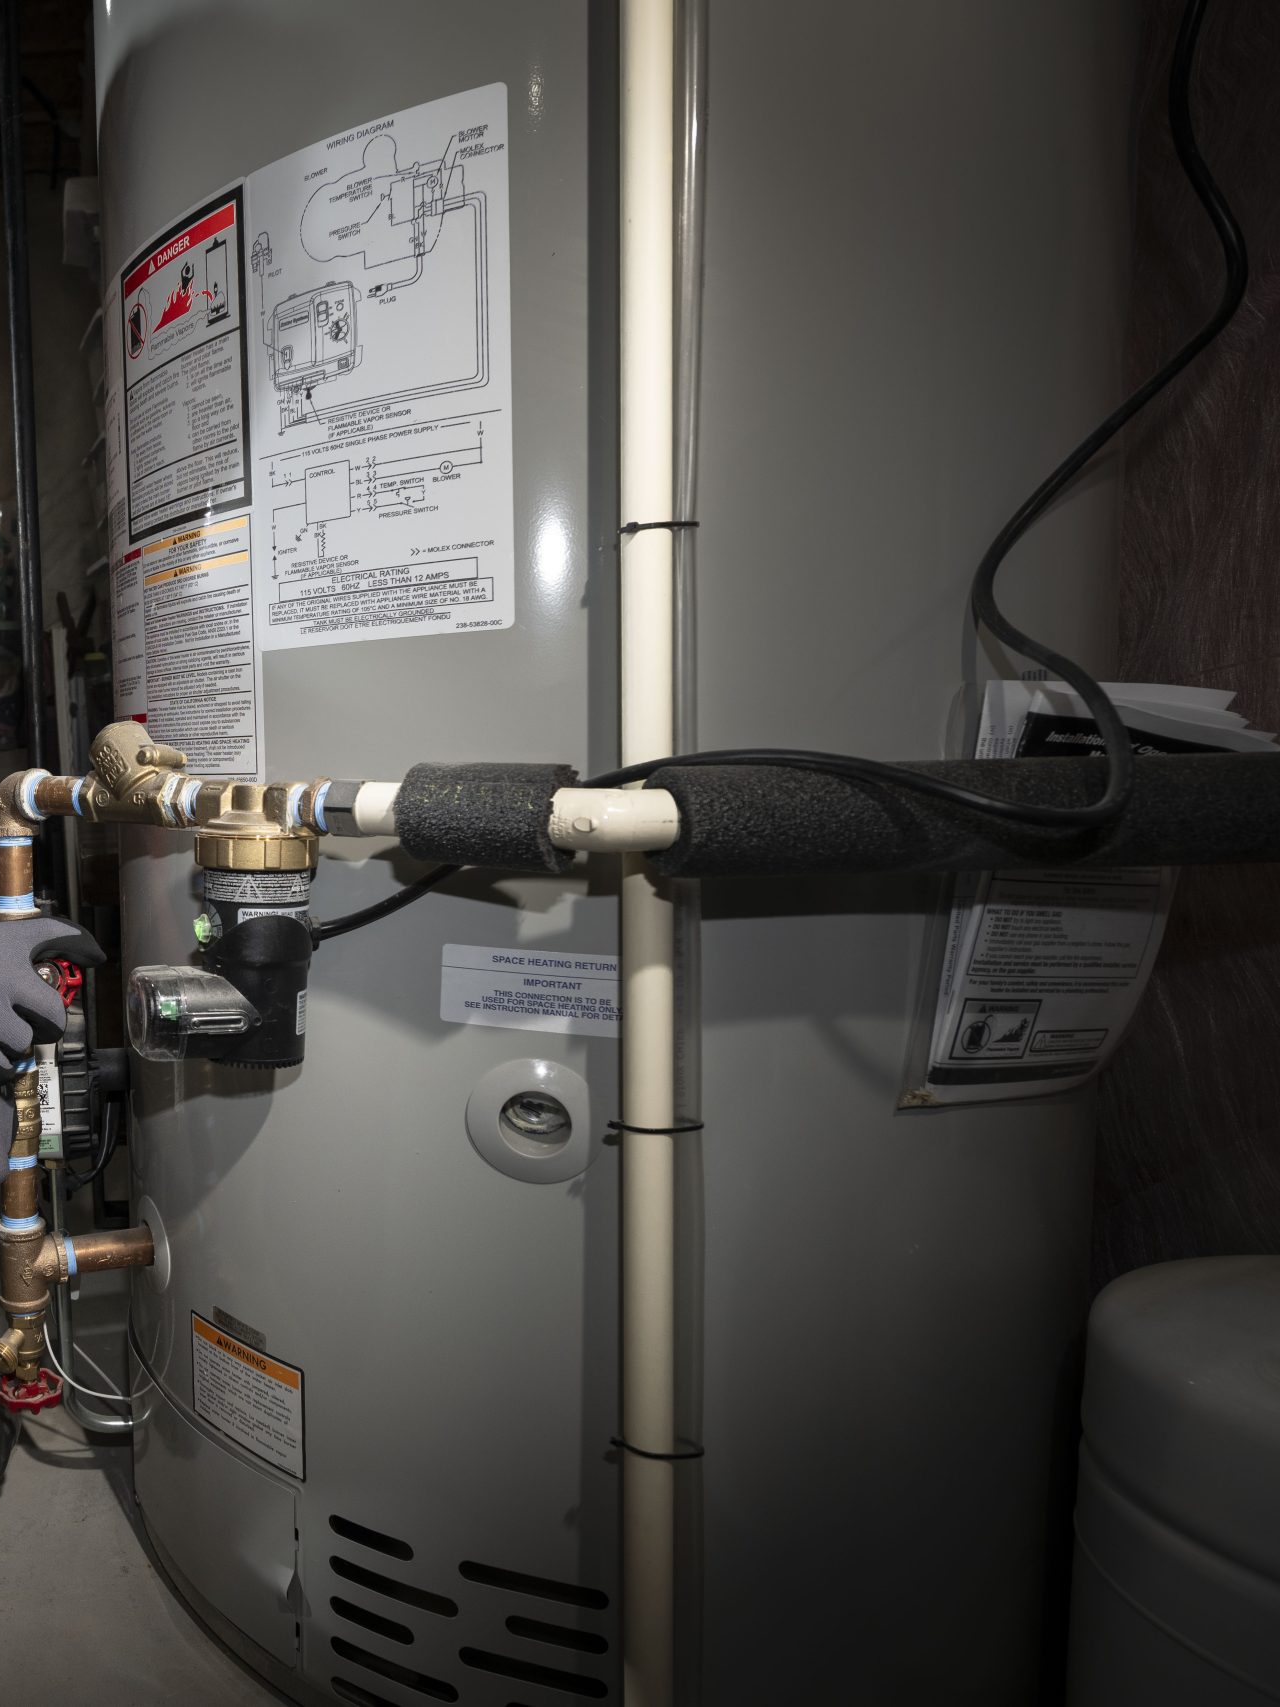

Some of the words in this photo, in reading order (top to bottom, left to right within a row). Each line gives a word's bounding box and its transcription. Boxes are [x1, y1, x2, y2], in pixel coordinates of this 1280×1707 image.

[326, 133, 355, 151] WIRING
[357, 119, 394, 142] DIAGRAM
[458, 124, 488, 137] BLOWER
[458, 132, 484, 144] MOTOR
[459, 143, 484, 154] MOLEX
[460, 143, 505, 160] CONNECTOR
[304, 167, 328, 182] BLOWER
[346, 177, 373, 191] BLOWER
[329, 183, 373, 203] TEMPERATURE
[349, 190, 373, 203] SWITCH
[328, 222, 361, 238] PRESSURE
[337, 229, 361, 241] SWITCH
[157, 235, 190, 267] DANGER
[379, 296, 396, 305] PLUG
[328, 411, 357, 424] RESISTIVE
[358, 408, 380, 417] DEVICE
[328, 418, 363, 431] FLAMMABLE
[363, 414, 384, 423] VAPOR
[385, 408, 412, 419] SENSOR
[328, 431, 336, 439] (IF
[336, 425, 373, 437] APPLICABLE)
[312, 446, 329, 455] VOLTS
[330, 443, 344, 452] 60HZ
[345, 438, 366, 449] SINGLE
[367, 433, 388, 443] PHASE
[389, 429, 412, 439] POWER
[413, 425, 439, 435] SUPPLY
[309, 469, 335, 479] CONTROL
[400, 477, 424, 486] SWITCH
[432, 473, 461, 483] BLOWER
[378, 509, 412, 519] PRESSURE
[413, 505, 439, 514] SWITCH
[178, 530, 200, 543] WARNING
[168, 547, 176, 555] FOR
[177, 544, 189, 552] YOUR
[189, 539, 207, 548] SAFETY
[278, 547, 297, 555] IGNITER
[427, 545, 450, 553] MOLEX
[451, 540, 494, 550] CONNECTOR
[179, 563, 202, 575] WARNING
[285, 566, 315, 576] FLAMMABLE
[316, 563, 335, 571] VAPOR
[335, 560, 359, 568] SENSOR
[291, 560, 317, 568] RESISTIVE
[319, 556, 338, 564] DEVICE
[332, 571, 378, 584] ELECTRICAL
[380, 567, 410, 577] RATING
[313, 586, 336, 595] VOLTS
[341, 582, 360, 591] 60HZ
[367, 578, 388, 587] LESS
[390, 576, 411, 585] THAN
[425, 572, 449, 581] AMPS
[307, 598, 332, 606] ORIGINAL
[352, 592, 380, 600] SUPPLIED
[412, 583, 448, 592] APPLIANCE
[329, 600, 359, 609] REPLACED
[376, 594, 410, 603] APPLIANCE
[429, 589, 462, 598] MATERIAL
[294, 611, 330, 620] TEMPERATURE
[396, 600, 423, 608] MINIMUM
[354, 612, 396, 622] ELECTRICALLY
[399, 608, 434, 616] GROUNDED
[492, 955, 525, 965] SPACE
[528, 958, 572, 969] HEATING
[575, 961, 617, 972] RETURN
[524, 978, 582, 990] IMPORTANT
[482, 996, 505, 1004] USED
[507, 998, 525, 1006] FOR
[527, 1000, 556, 1008] SPACE
[558, 1003, 596, 1013] HEATING
[494, 990, 513, 998] THIS
[515, 991, 572, 1003] CONNECTION
[574, 996, 582, 1004] IS
[585, 997, 597, 1005] TO
[464, 1001, 481, 1009] SEE
[483, 1003, 540, 1014] INSTRUCTION
[542, 1009, 579, 1018] MANUAL
[582, 1012, 600, 1020] FOR
[223, 1338, 266, 1371] WARNING
